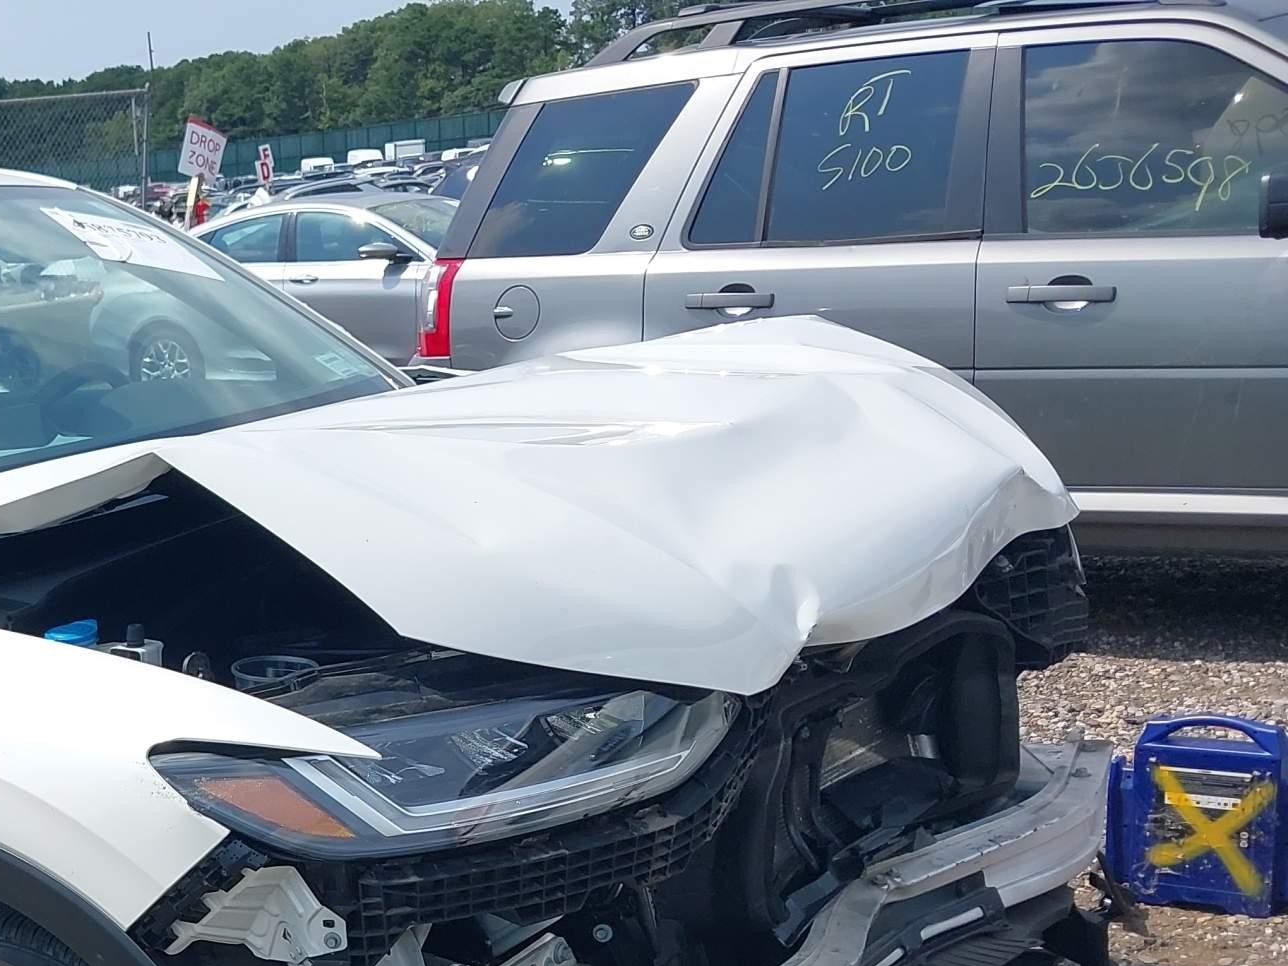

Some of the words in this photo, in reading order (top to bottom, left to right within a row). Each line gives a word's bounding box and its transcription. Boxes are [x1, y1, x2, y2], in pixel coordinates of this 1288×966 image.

[840, 70, 911, 136] RT
[189, 131, 221, 155] DROP
[187, 150, 217, 176] ZONE
[260, 162, 270, 181] D
